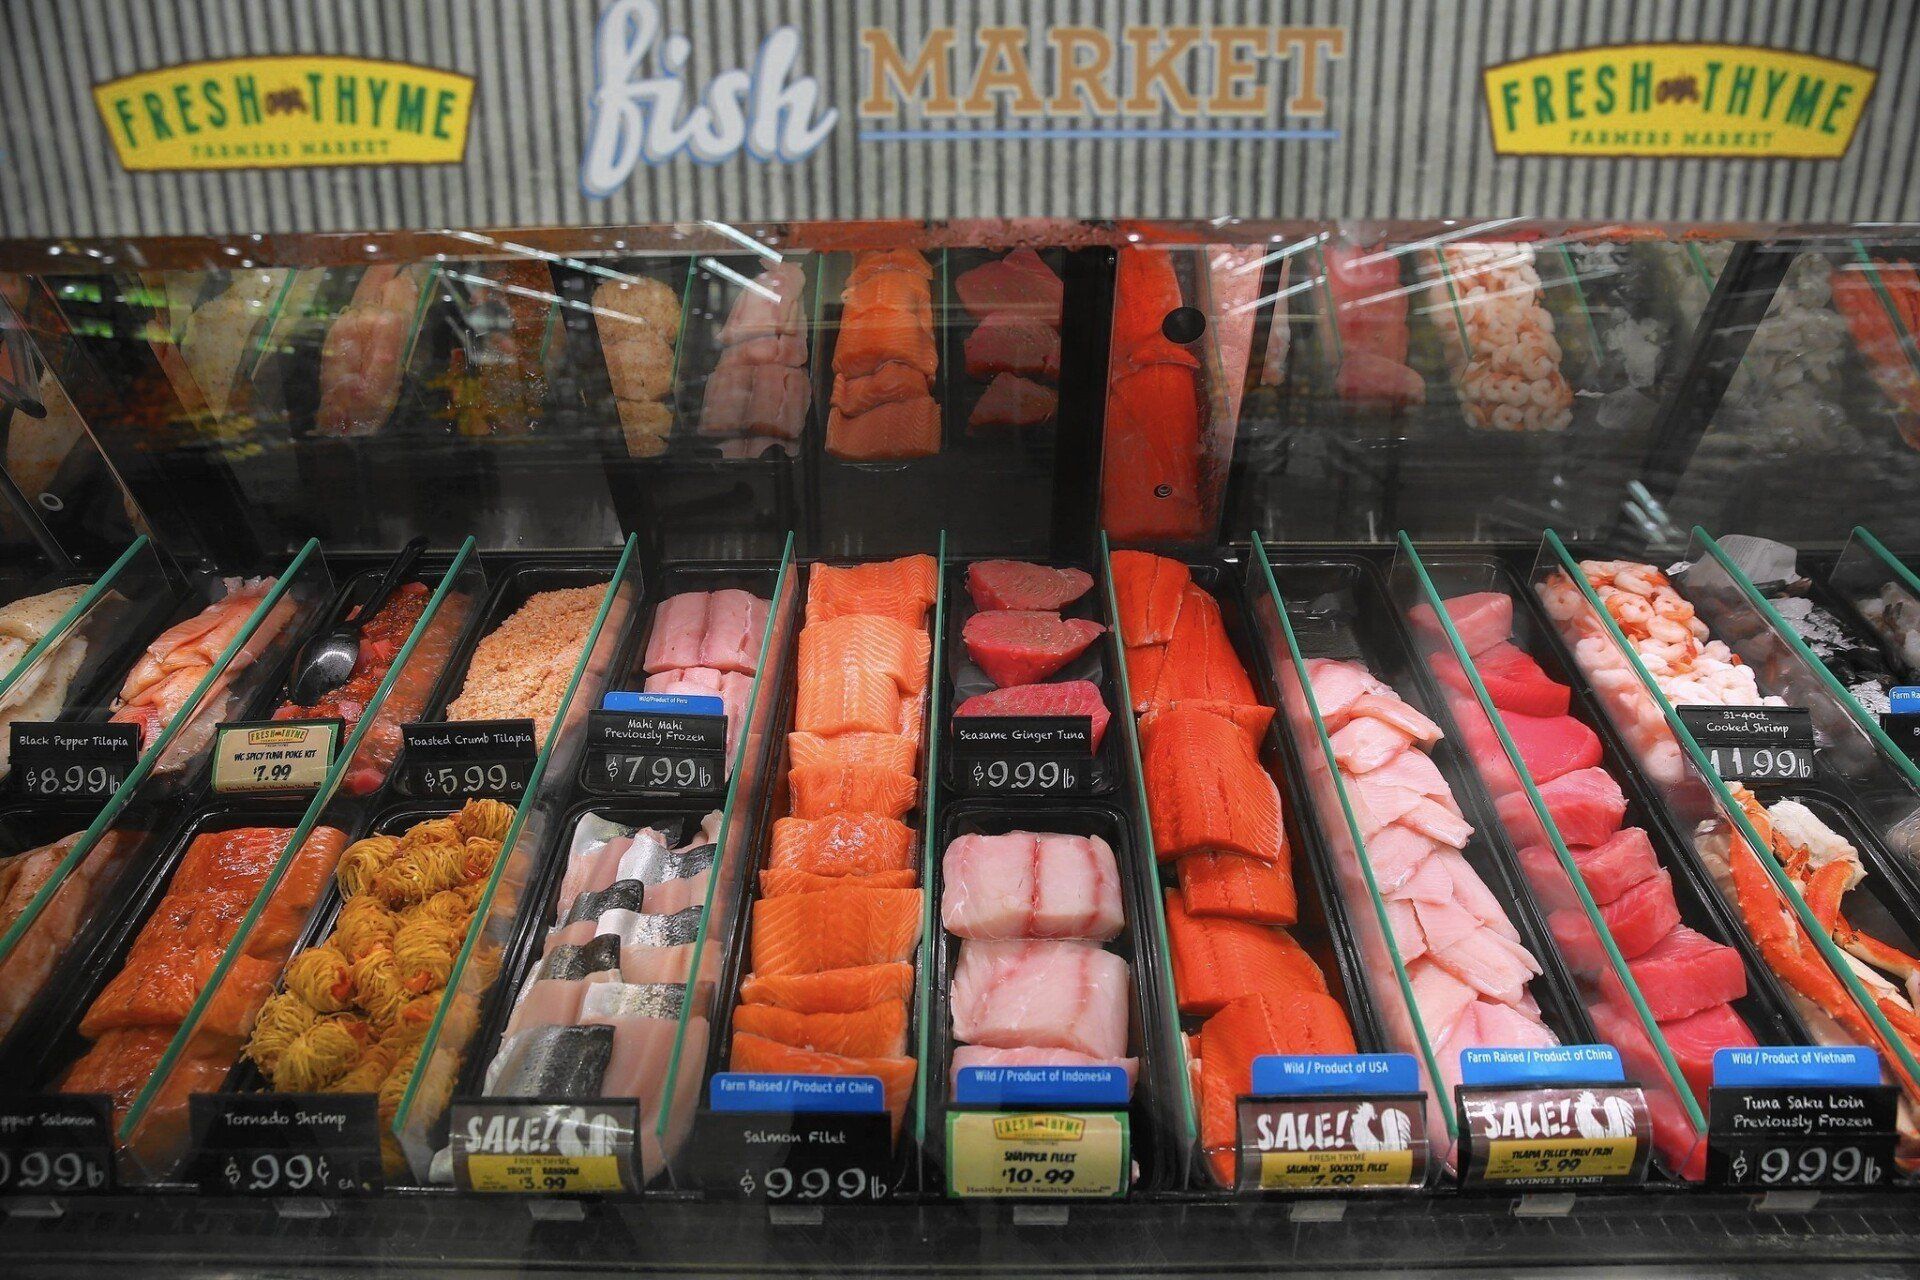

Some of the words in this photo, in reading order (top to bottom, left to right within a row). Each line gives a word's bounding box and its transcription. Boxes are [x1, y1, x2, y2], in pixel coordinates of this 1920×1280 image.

[580, 0, 840, 200] fish
[859, 25, 1345, 117] MARKET
[1501, 60, 1653, 133] FRESH
[1700, 61, 1854, 134] THYME
[114, 73, 263, 149] FRESH
[306, 72, 455, 140] THYME
[628, 719, 652, 729] Mahi
[658, 721, 683, 731] Mahi
[1706, 723, 1749, 732] Cooked
[1752, 723, 1789, 738] Shrimp
[251, 730, 275, 741] FRESH
[281, 728, 305, 739] THYME
[408, 735, 451, 746] Toasted
[455, 733, 490, 745] Crumb
[493, 733, 532, 747] Tilapia
[605, 727, 662, 745] Previously
[666, 731, 705, 742] Frozen
[960, 730, 1007, 740] Seasame
[1012, 730, 1053, 743] Ginger
[1057, 730, 1085, 740] Tuna
[19, 736, 49, 746] Black
[54, 735, 89, 750] Pepper
[92, 736, 128, 751] Tilapia
[246, 752, 265, 760] SPICY
[266, 751, 283, 759] TUNA
[285, 750, 303, 759] POKE
[304, 749, 317, 758] KIT
[253, 764, 292, 782] $7.99
[510, 782, 522, 790] EA
[1467, 1053, 1491, 1063] Farm
[1494, 1052, 1524, 1063] Raised
[1527, 1051, 1531, 1063] /
[1534, 1051, 1571, 1062] Product
[1574, 1050, 1584, 1061] of
[1586, 1050, 1613, 1060] China
[1732, 1053, 1752, 1064] Wild
[1755, 1053, 1759, 1065] /
[1762, 1053, 1799, 1064] Product
[1802, 1052, 1812, 1063] of
[1814, 1052, 1856, 1063] Vietnam
[1284, 1062, 1304, 1074] Wild
[1307, 1062, 1312, 1075] /
[1315, 1062, 1353, 1074] Product
[1356, 1062, 1366, 1073] of
[1369, 1061, 1389, 1073] USA
[975, 1070, 996, 1082] Wild
[998, 1070, 1004, 1082] /
[1007, 1071, 1046, 1082] Product
[1049, 1071, 1060, 1082] of
[1062, 1070, 1112, 1082] Indonesia
[720, 1079, 746, 1092] Farm
[749, 1079, 783, 1092] Raised
[785, 1080, 790, 1093] /
[793, 1080, 832, 1093] Product
[835, 1081, 846, 1093] of
[848, 1081, 874, 1094] Chile
[1743, 1096, 1781, 1110] Tuna
[1787, 1096, 1824, 1108] Saku
[1830, 1095, 1864, 1108] Loin
[225, 1110, 289, 1126] Tornado
[295, 1111, 346, 1132] Shrimp
[1481, 1098, 1571, 1139] SALE!
[1733, 1115, 1813, 1135] Previously
[1818, 1115, 1873, 1127] Frozen
[465, 1114, 560, 1153] SALE!
[744, 1130, 802, 1144] Salmon
[809, 1130, 847, 1144] Filet
[1257, 1110, 1349, 1150] SALE!
[1004, 1151, 1048, 1162] SNAPPER
[1339, 1153, 1365, 1161] THYME
[1286, 1164, 1321, 1174] SALMON
[1329, 1163, 1365, 1173] SOCKEYE
[1505, 1177, 1556, 1185] SAVINGS
[1560, 1176, 1603, 1184] THYME!
